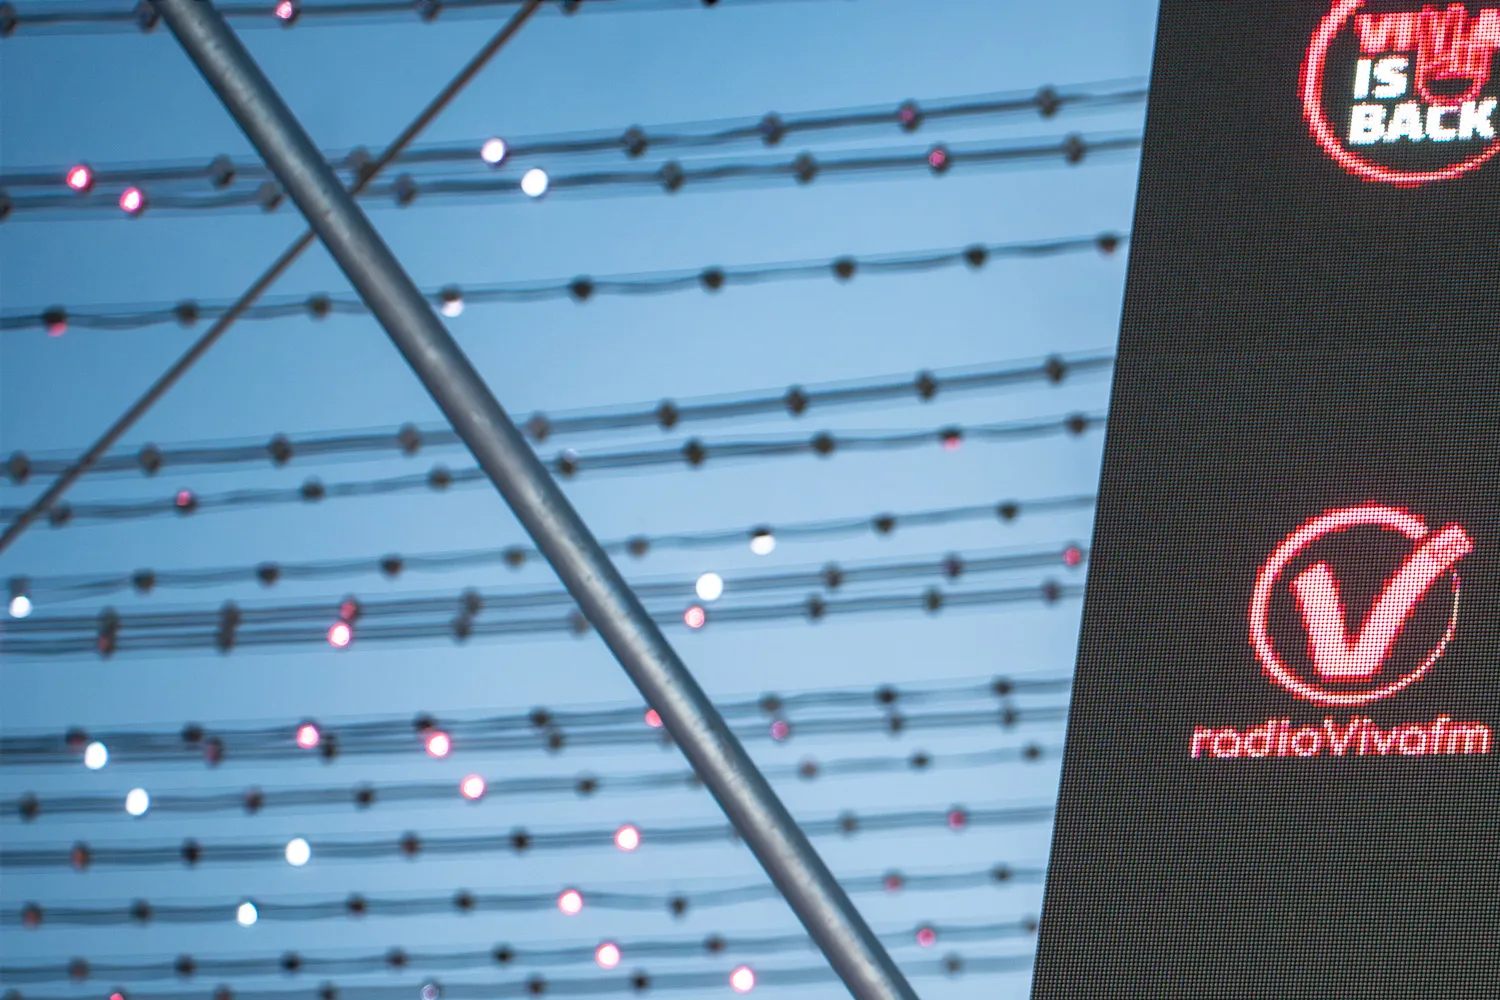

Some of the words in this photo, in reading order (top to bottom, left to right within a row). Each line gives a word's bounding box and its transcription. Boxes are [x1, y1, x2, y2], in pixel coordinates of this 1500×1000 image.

[1353, 55, 1410, 101] IS
[1348, 97, 1498, 145] BACK
[1189, 714, 1493, 757] radioVivafm
